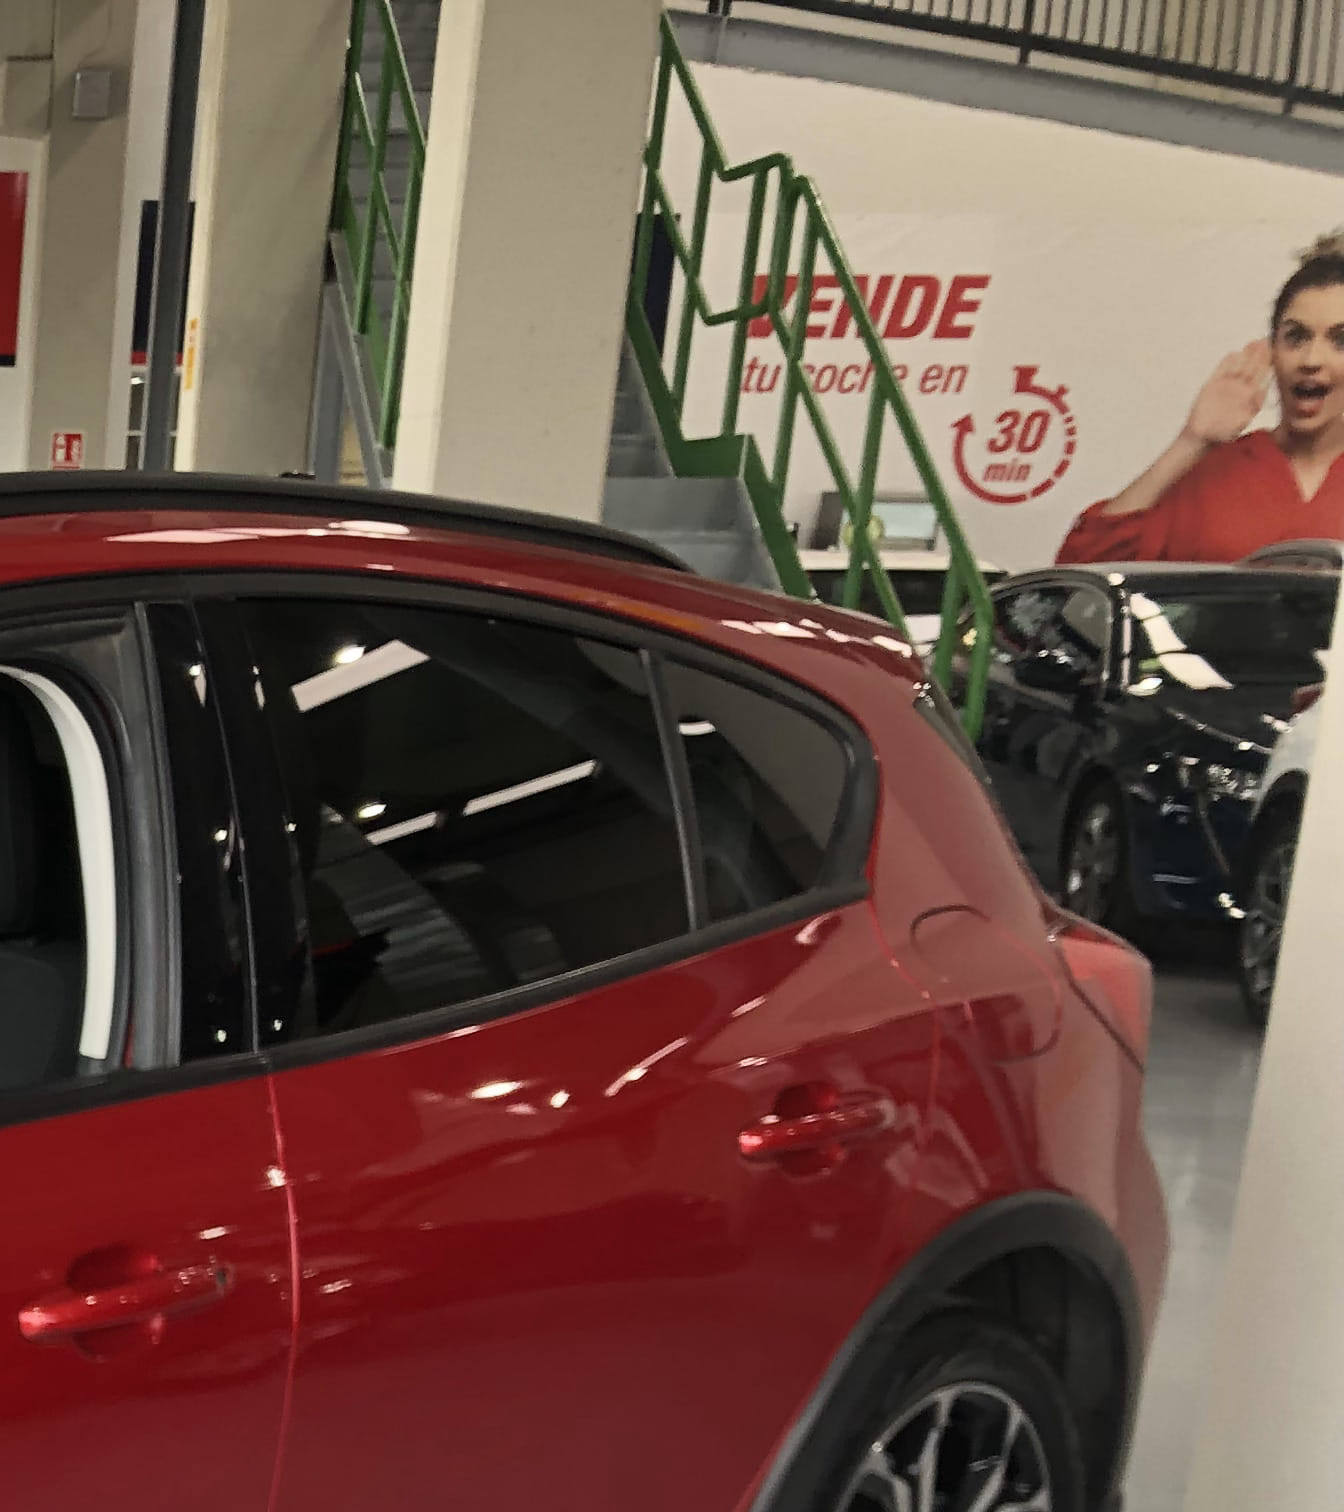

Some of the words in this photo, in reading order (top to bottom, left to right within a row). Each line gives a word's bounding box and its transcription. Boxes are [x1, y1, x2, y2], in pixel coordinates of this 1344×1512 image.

[747, 274, 992, 339] VENDE
[743, 356, 781, 393] tu
[802, 358, 909, 394] oce
[918, 364, 969, 394] en
[987, 410, 1051, 453] 30
[983, 458, 1032, 482] min
